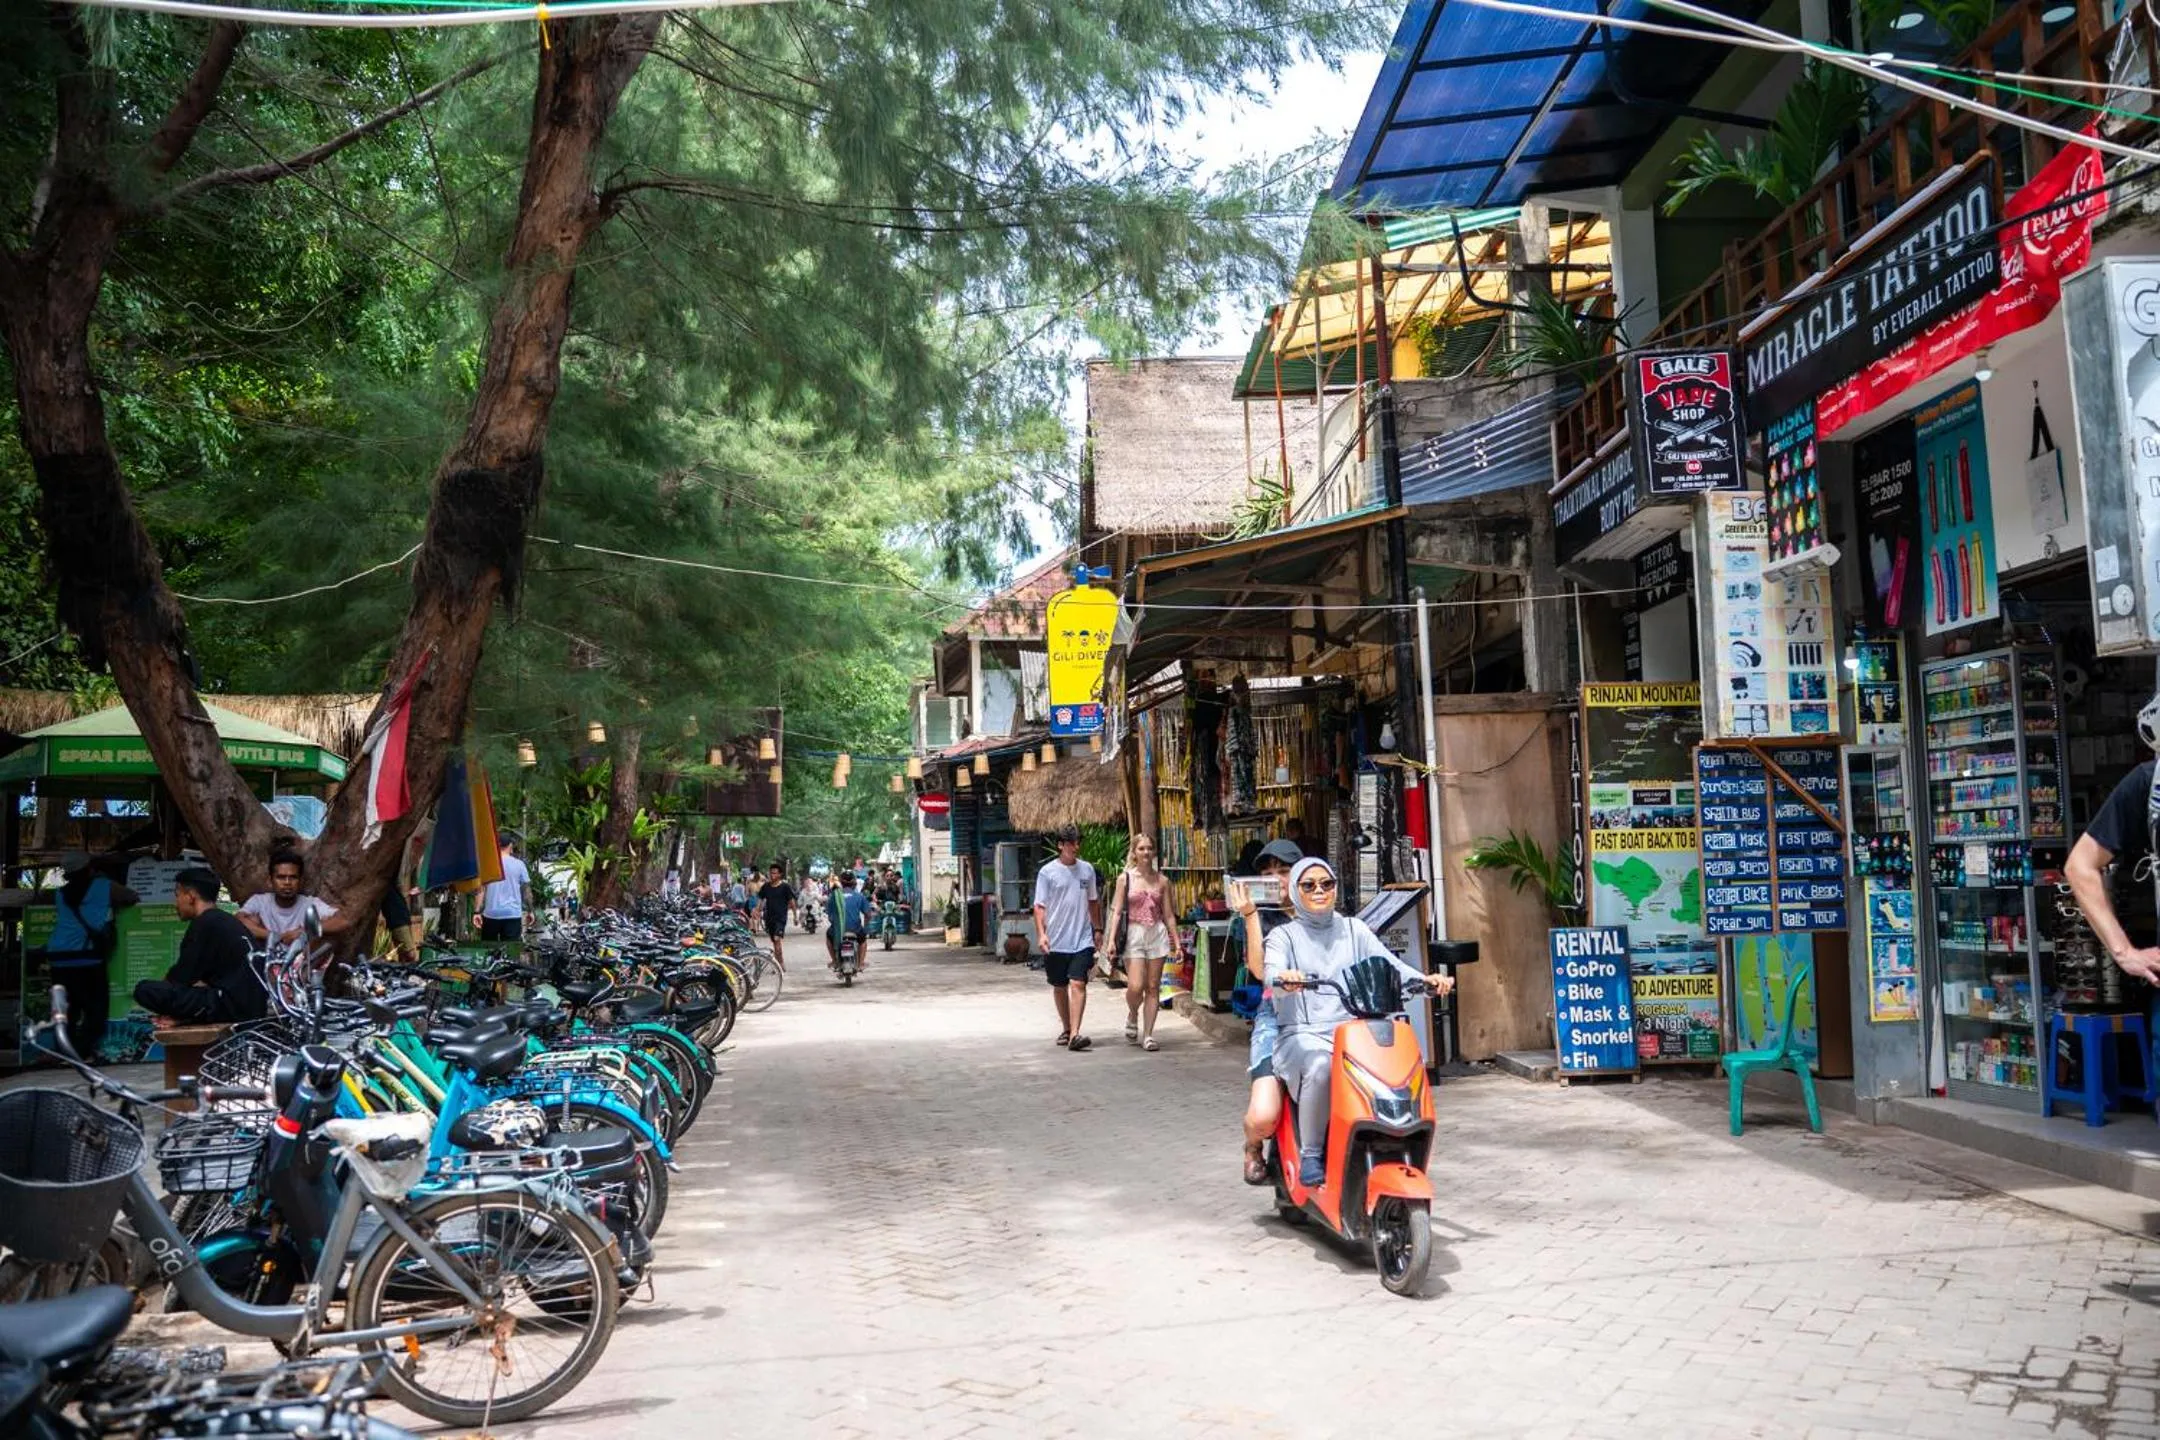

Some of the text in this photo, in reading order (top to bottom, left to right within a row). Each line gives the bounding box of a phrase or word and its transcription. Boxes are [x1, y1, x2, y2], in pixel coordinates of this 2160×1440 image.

[1747, 282, 1857, 393] MIRACLE
[1866, 184, 1989, 311] TATTOO
[1872, 311, 1893, 345] BY
[1892, 285, 1943, 335] EVERALL
[1945, 252, 1993, 297] TATTOO
[1660, 359, 1709, 376] BALE
[1658, 387, 1717, 410] VAPE
[1672, 408, 1706, 420] SHOP
[1767, 400, 1813, 443] HUSKY
[1891, 459, 1912, 480] 1500
[1880, 481, 1903, 501] 2000
[1600, 493, 1621, 533] BODY
[1642, 542, 1673, 569] TATTOO
[1640, 560, 1678, 587] PIERCING
[1053, 652, 1074, 661] GILI
[1590, 687, 1637, 702] RINJANI
[59, 749, 113, 763] SPEAR
[277, 749, 305, 763] BUS
[1570, 712, 1584, 904] TATTOO
[1595, 832, 1617, 849] FAST
[1621, 832, 1644, 849] BOAT
[1647, 832, 1674, 848] BACK
[1675, 832, 1687, 848] TO
[1556, 931, 1625, 957] RENTAL
[1566, 961, 1616, 977] GoPro
[1568, 984, 1604, 1000] Bike
[1648, 978, 1714, 996] ADVENTURE
[1569, 1005, 1631, 1023] Mask &
[1635, 1003, 1688, 1016] ROGRAM
[1644, 1017, 1652, 1030] 3
[1655, 1016, 1691, 1032] Night
[1571, 1028, 1634, 1046] Snorkel
[1573, 1052, 1598, 1069] Fin
